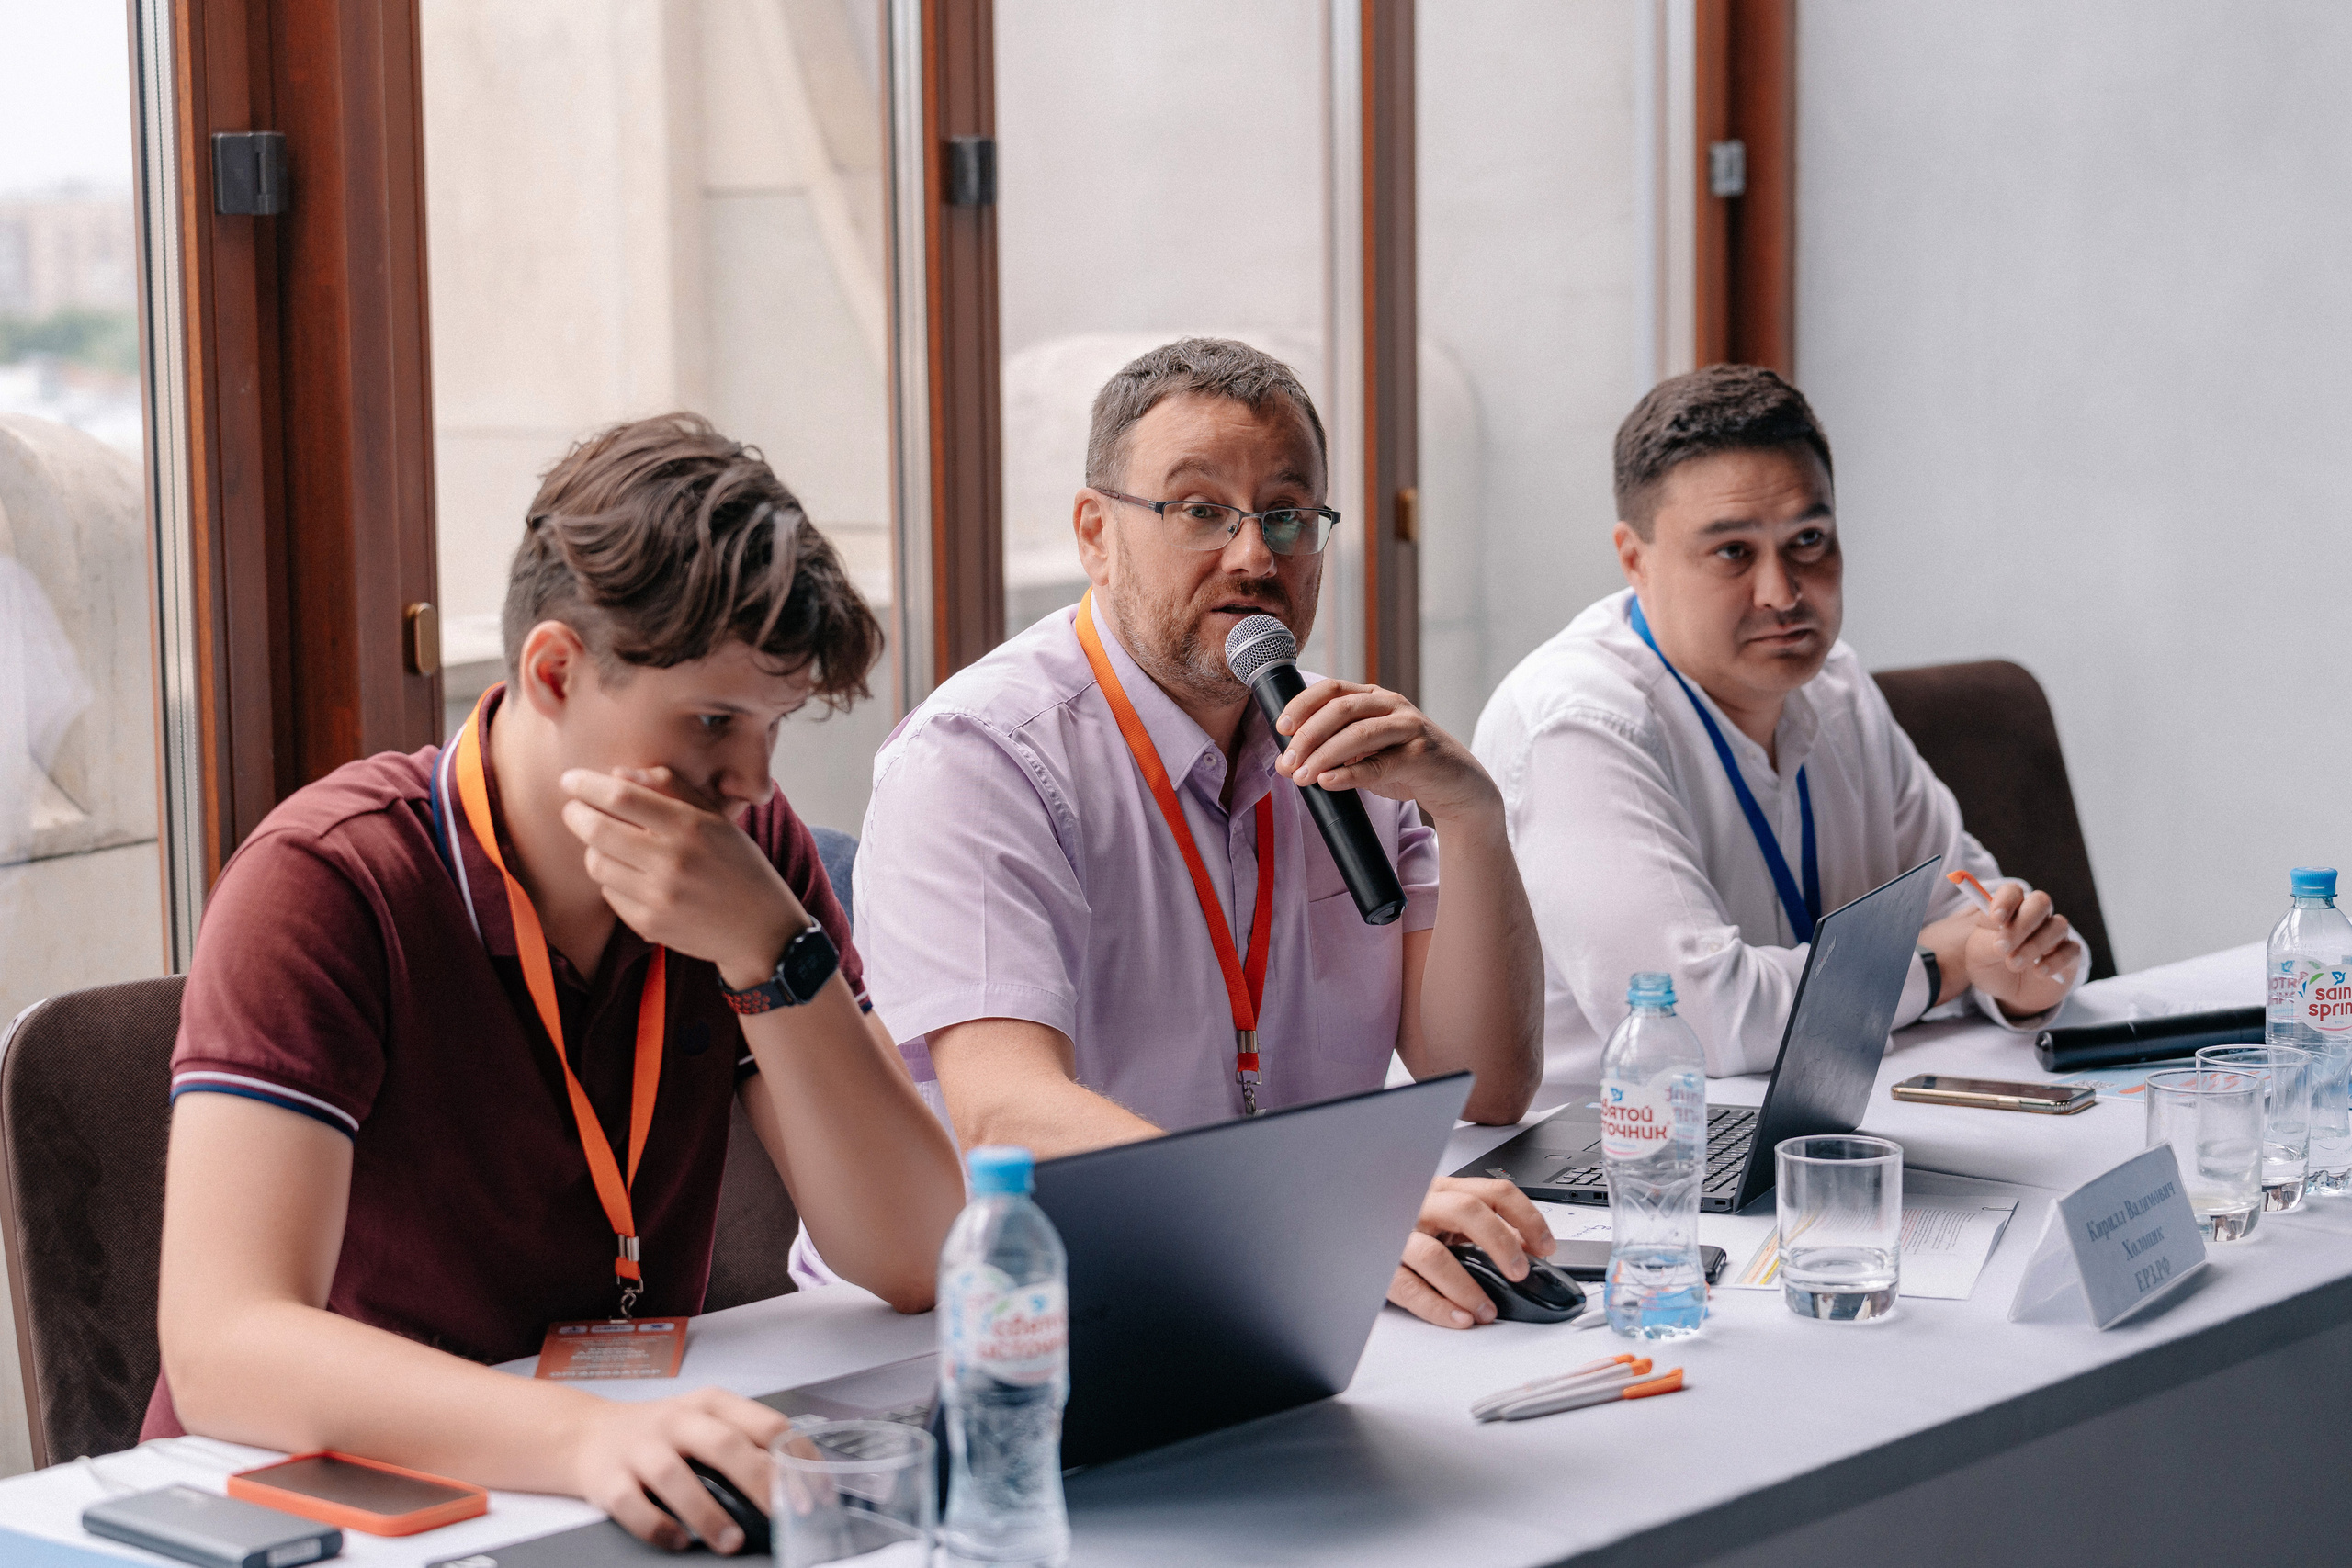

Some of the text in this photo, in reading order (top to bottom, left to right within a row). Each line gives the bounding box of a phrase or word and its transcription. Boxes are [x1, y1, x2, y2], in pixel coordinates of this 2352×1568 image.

[2315, 987, 2351, 1001] sain
[2309, 1002, 2352, 1021] sprin
[1600, 1098, 1653, 1122] вятой
[1600, 1121, 1668, 1140] точник
[2086, 1181, 2176, 1242] Кирилл Вадимович
[2122, 1226, 2165, 1261] Холопик
